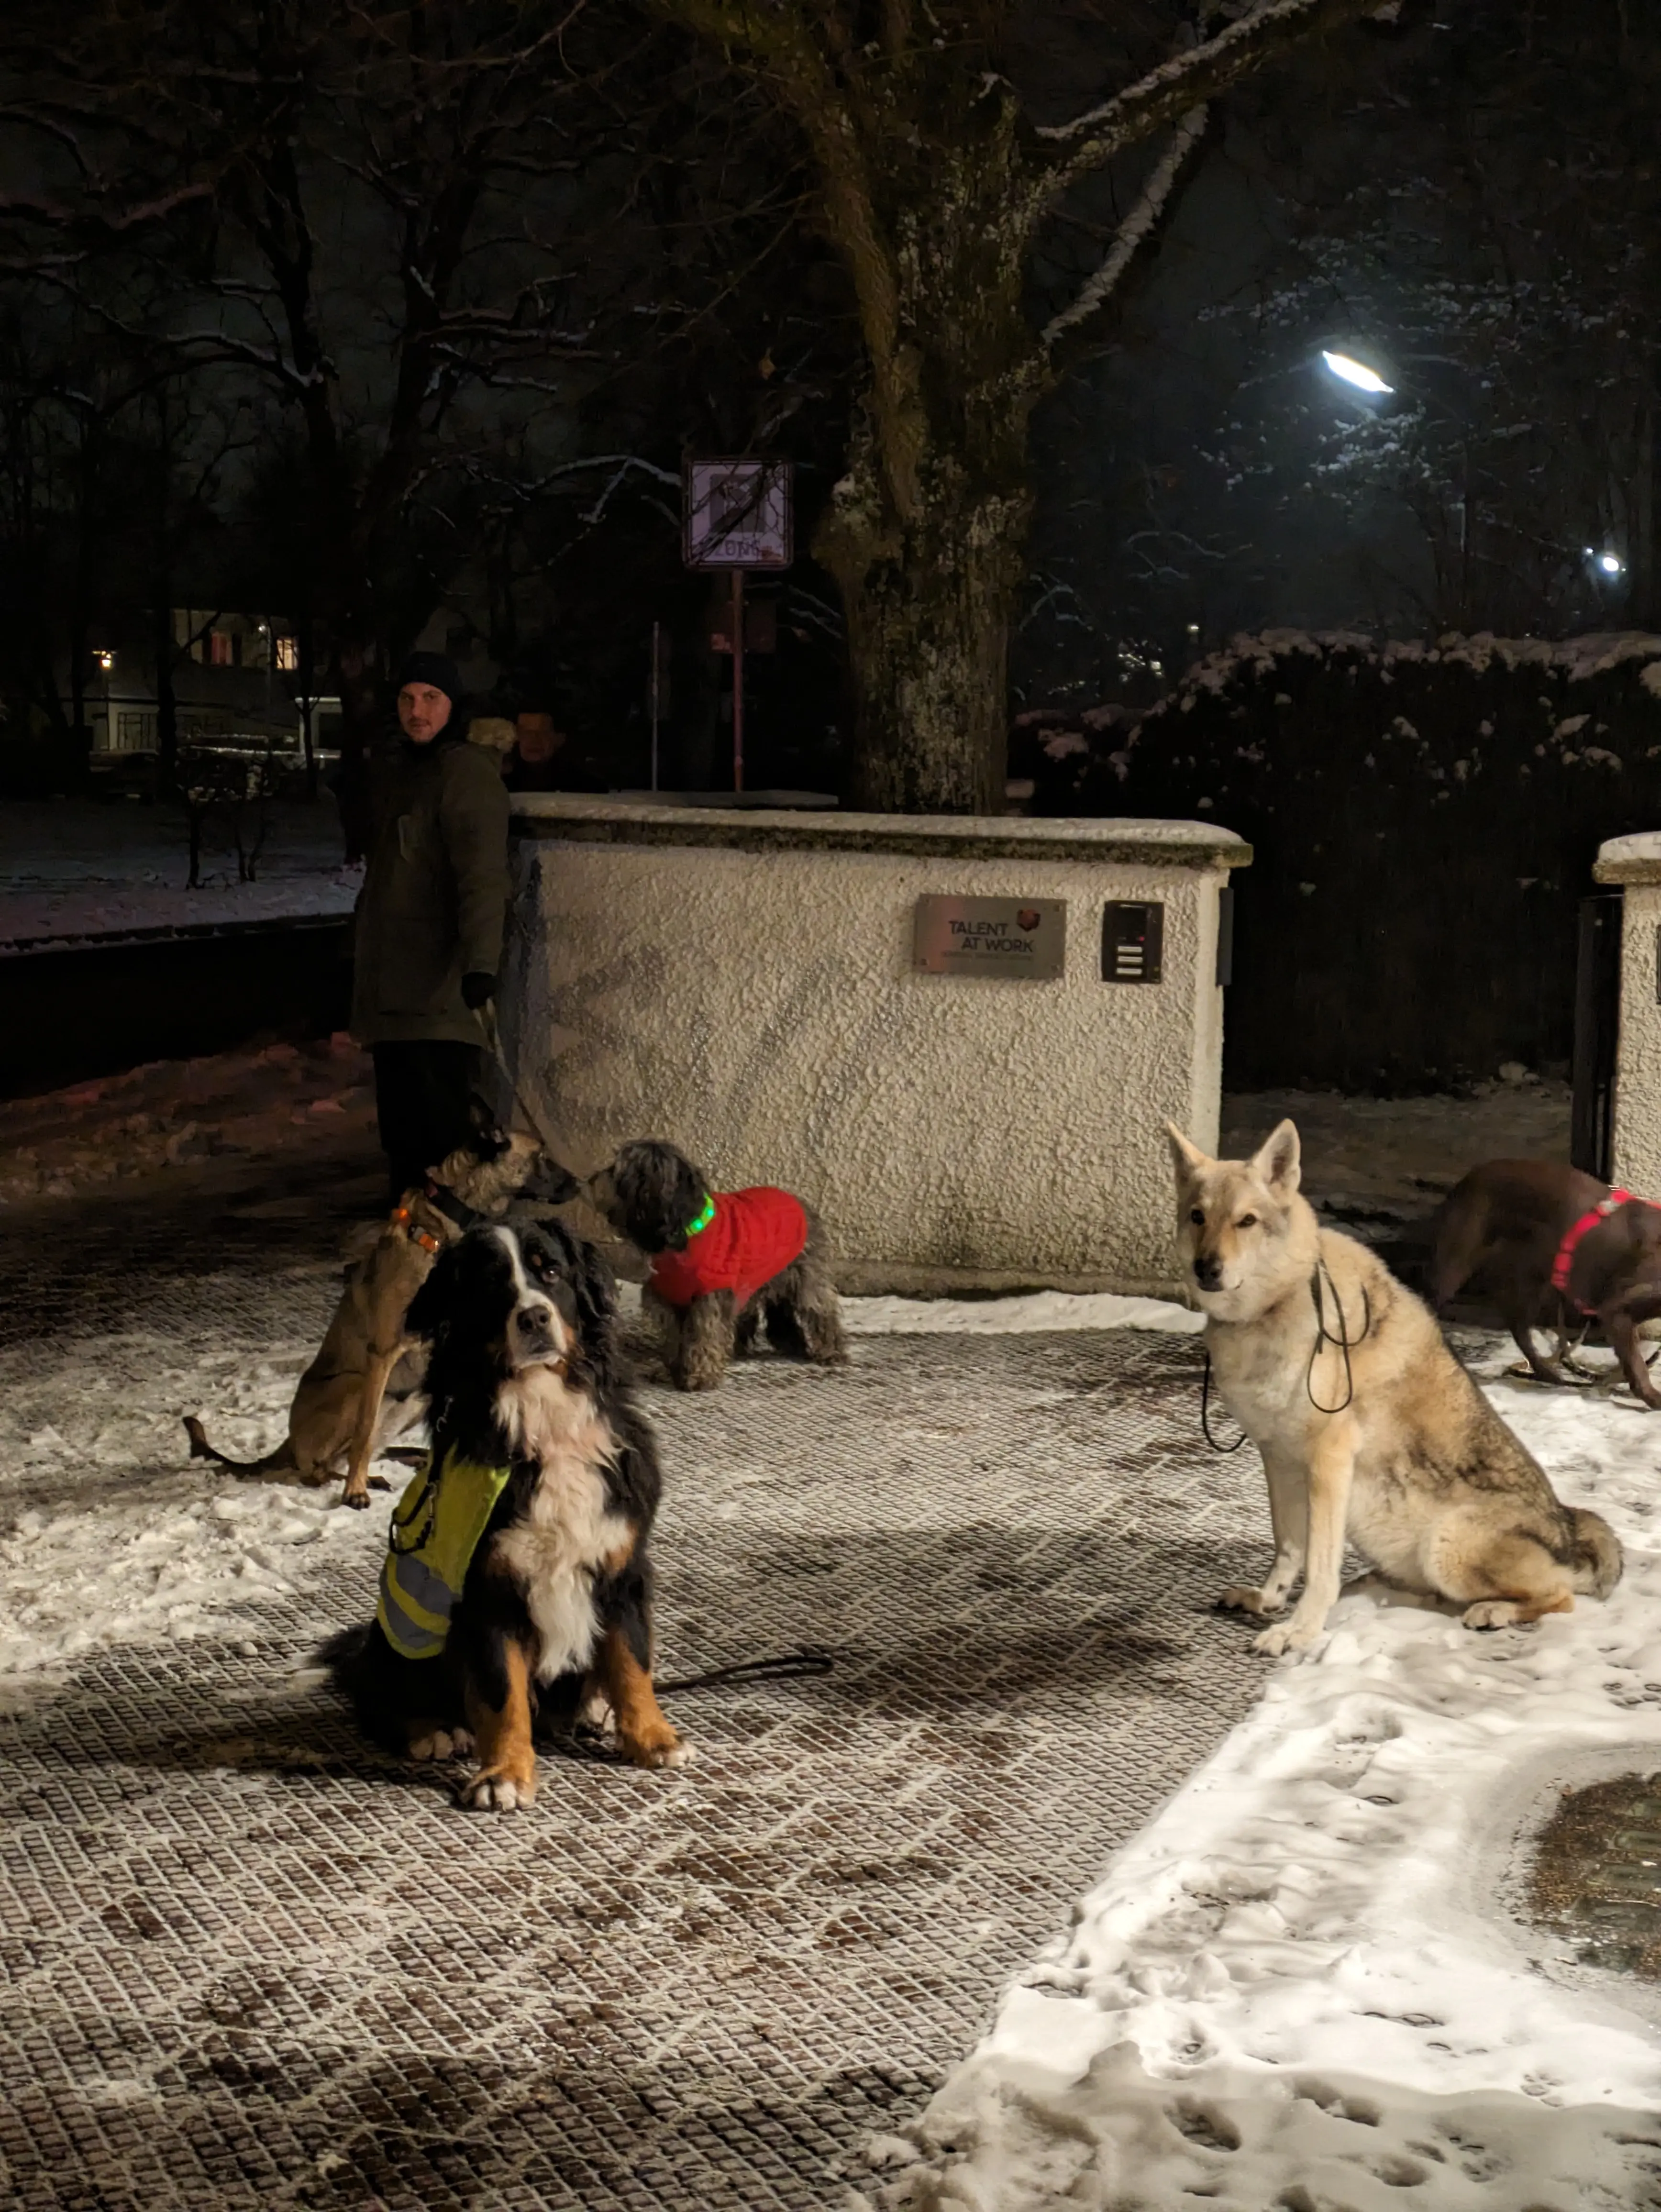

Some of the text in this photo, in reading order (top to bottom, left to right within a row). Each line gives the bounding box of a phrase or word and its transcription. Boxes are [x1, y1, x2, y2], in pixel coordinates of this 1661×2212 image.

[949, 921, 1008, 936] TALENT
[962, 937, 1034, 952] AT WORK
